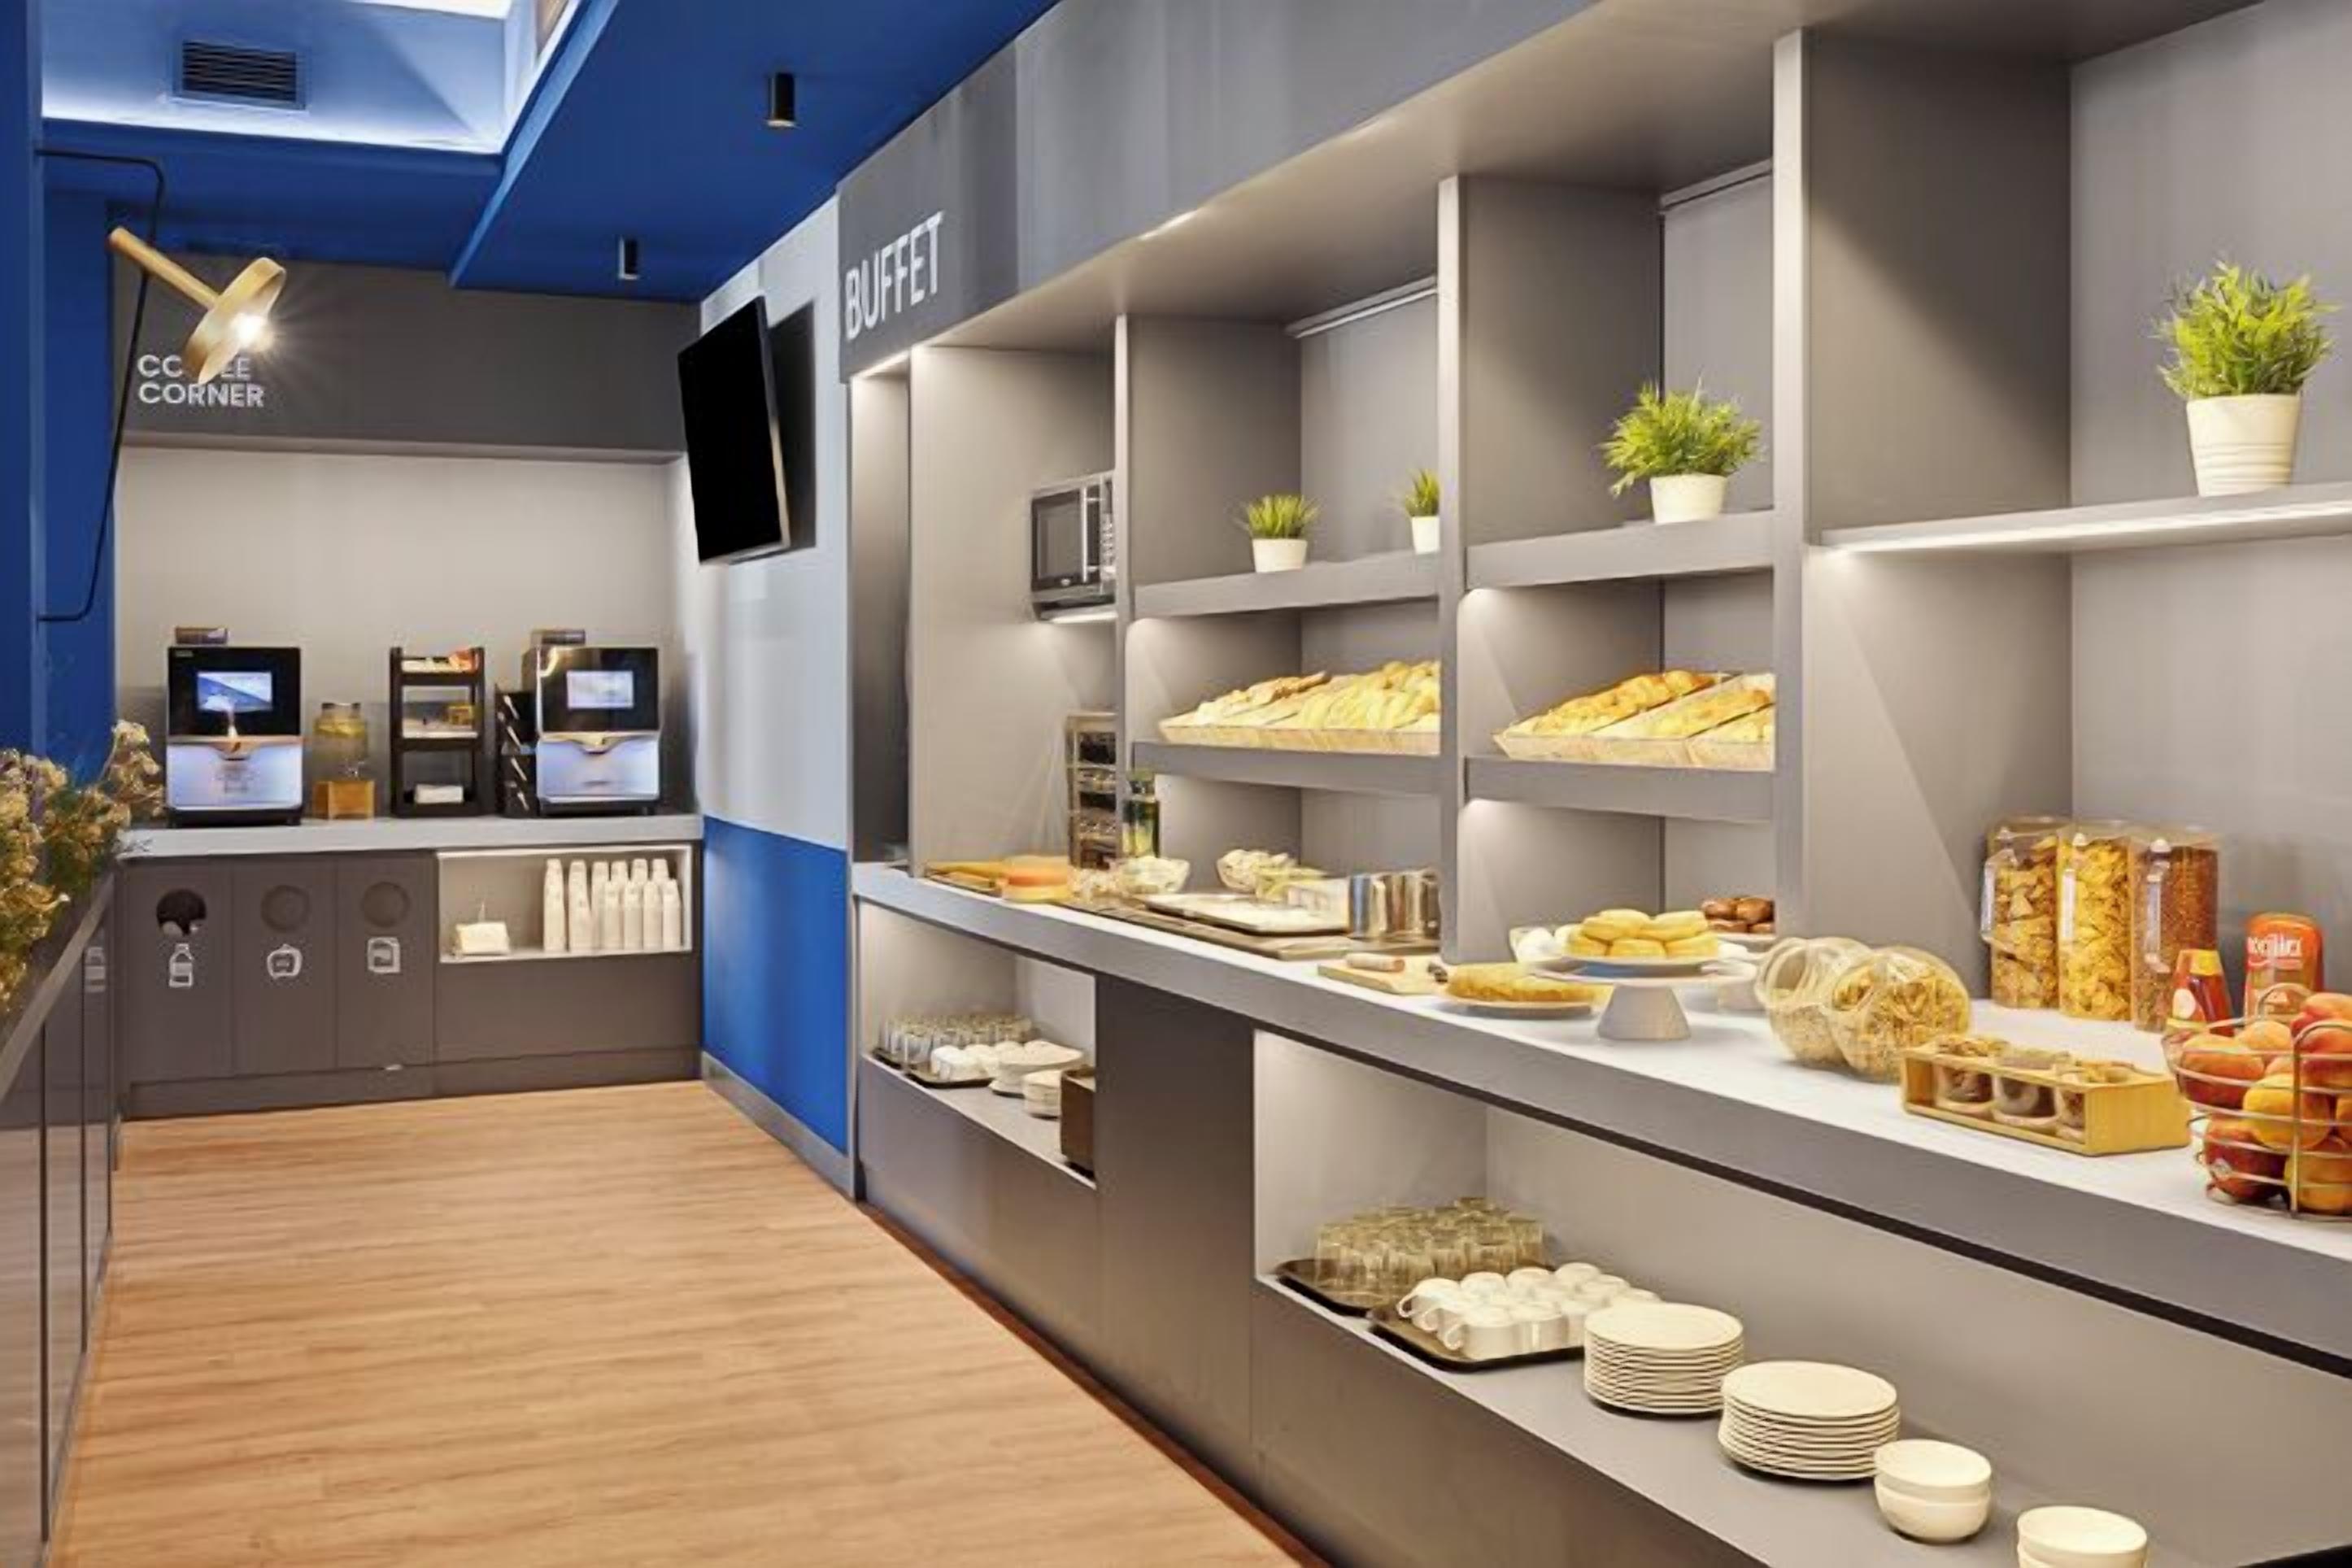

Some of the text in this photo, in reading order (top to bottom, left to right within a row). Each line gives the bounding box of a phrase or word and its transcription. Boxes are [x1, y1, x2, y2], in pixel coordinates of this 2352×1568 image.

[845, 210, 944, 341] BUFFET
[137, 354, 250, 379] COE
[138, 381, 264, 407] CORNER
